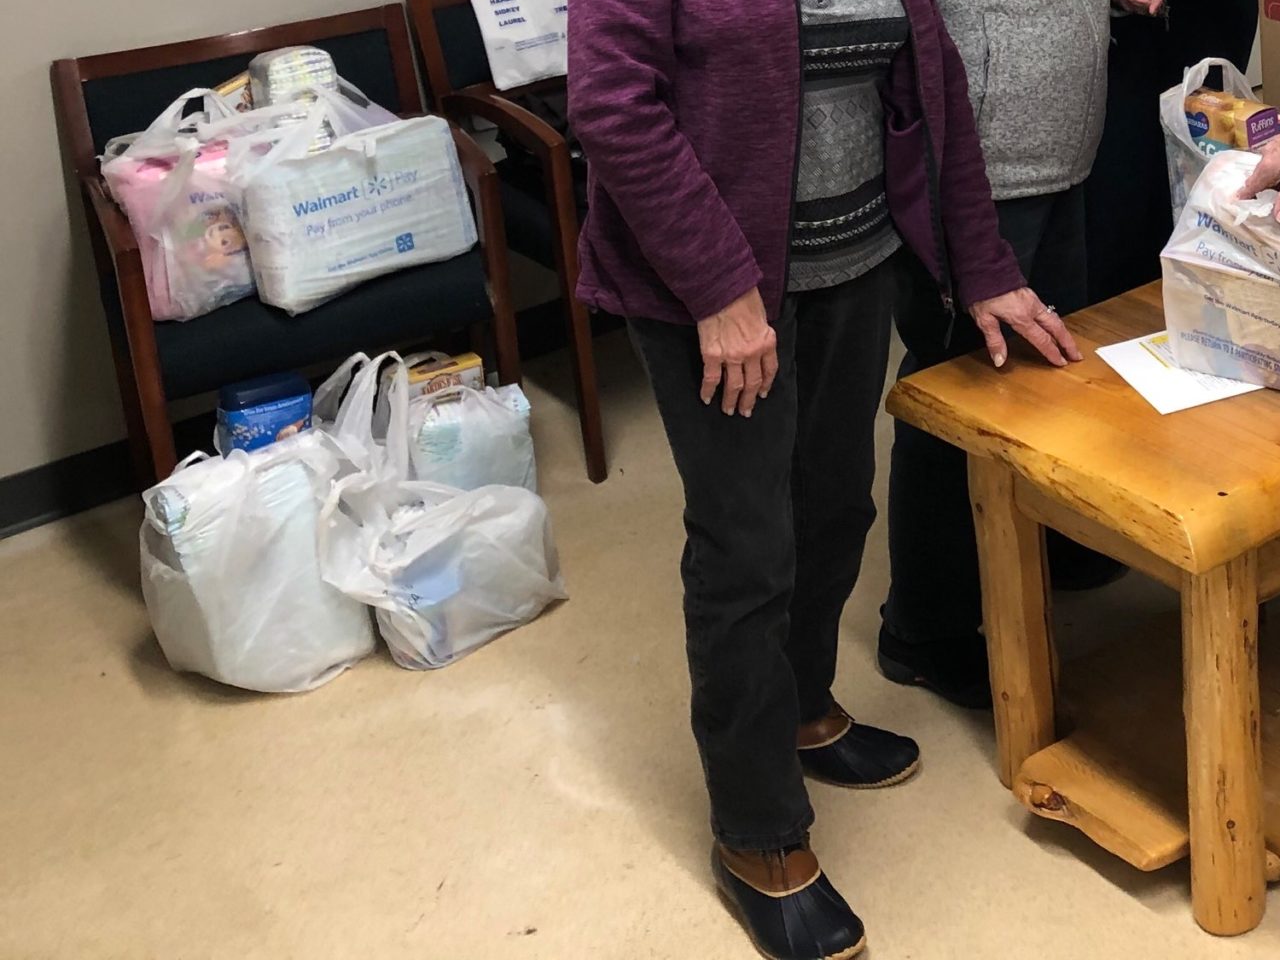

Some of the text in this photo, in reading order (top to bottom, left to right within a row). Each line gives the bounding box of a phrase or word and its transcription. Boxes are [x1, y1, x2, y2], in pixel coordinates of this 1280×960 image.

[499, 17, 526, 28] LAUREL
[1250, 117, 1275, 134] Puffins
[293, 185, 360, 218] Walmart
[306, 224, 326, 237] Pay
[327, 214, 354, 228] from
[355, 206, 377, 224] your
[1196, 241, 1216, 261] Pay
[1200, 336, 1222, 351] RETURN
